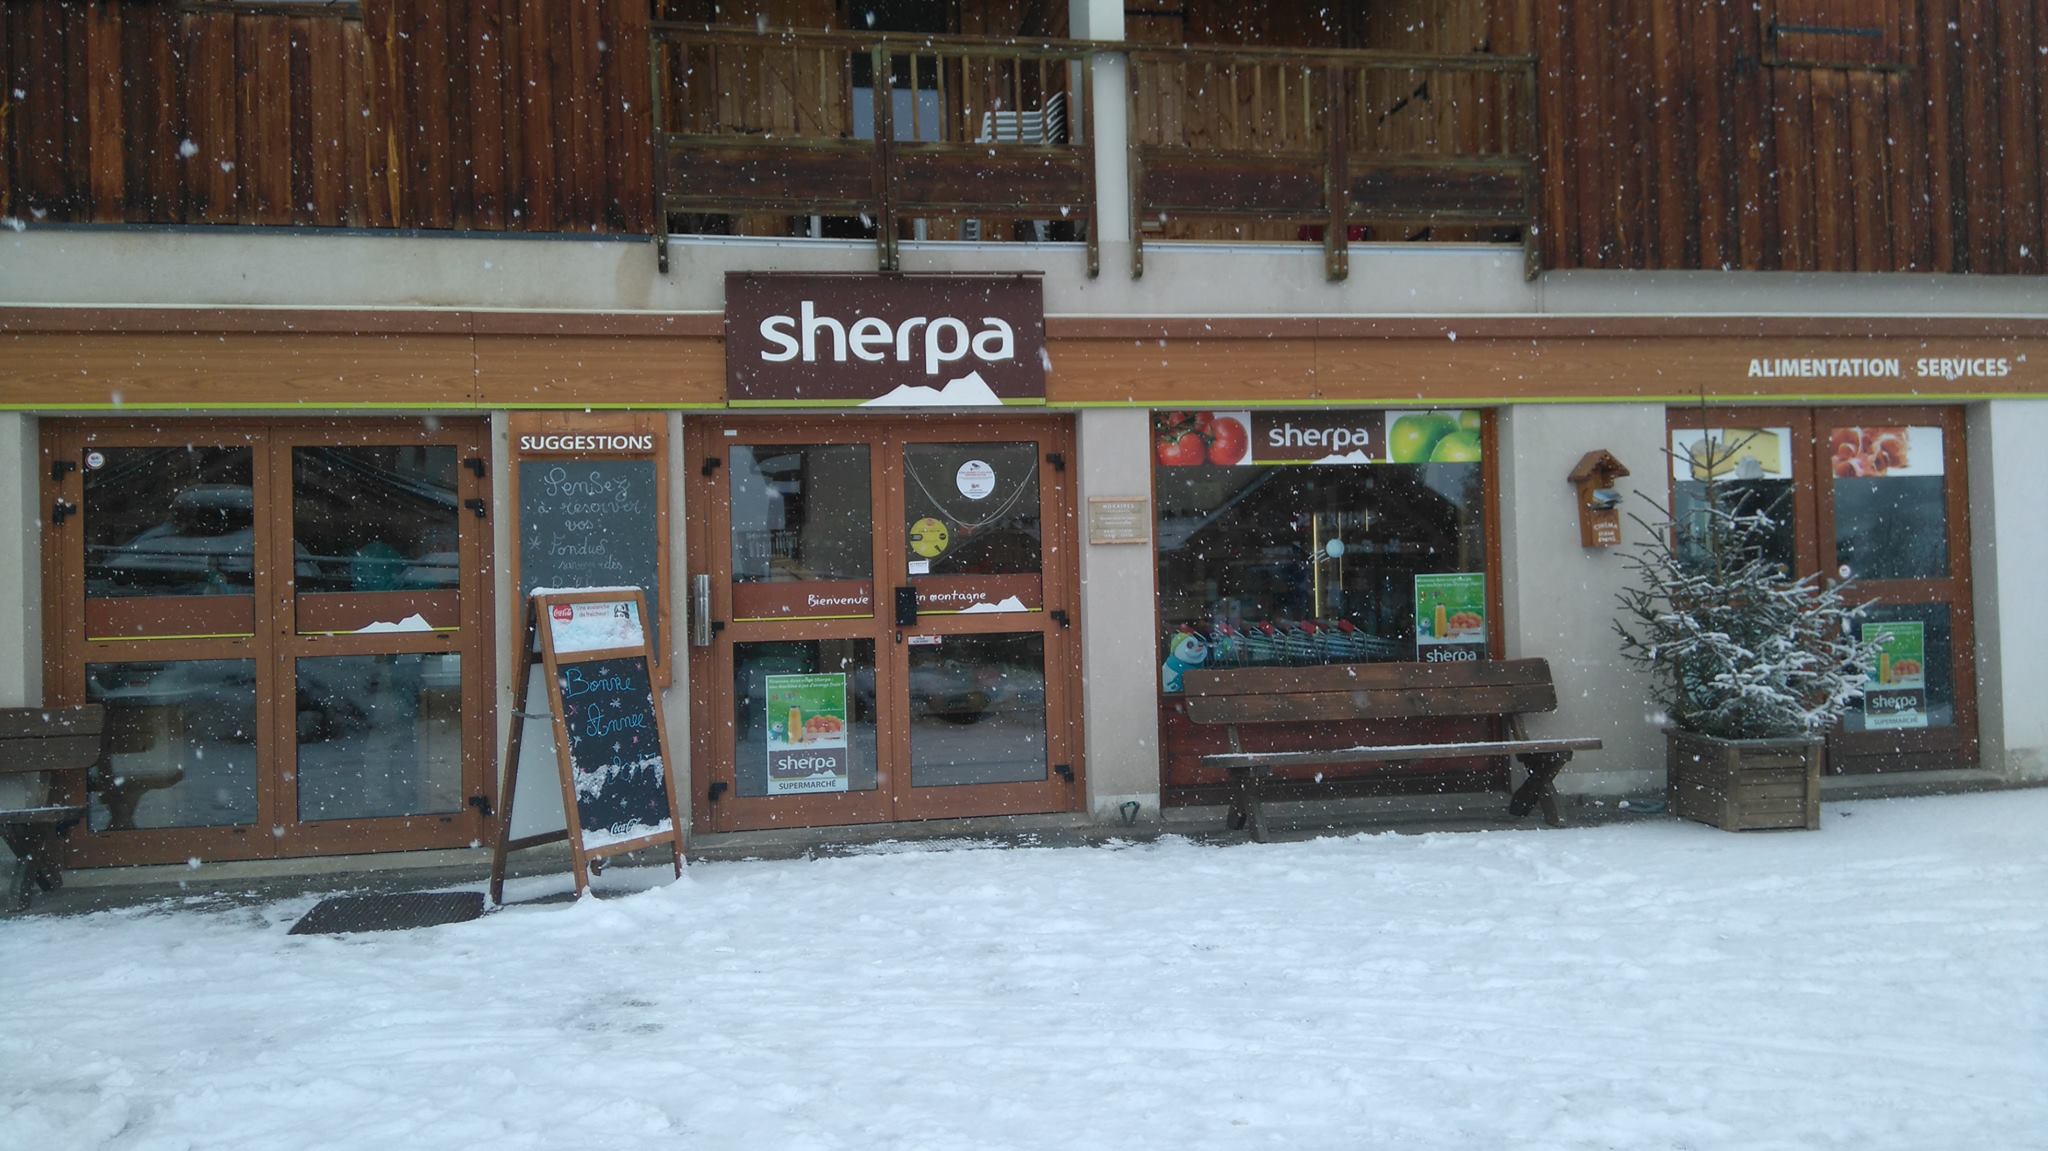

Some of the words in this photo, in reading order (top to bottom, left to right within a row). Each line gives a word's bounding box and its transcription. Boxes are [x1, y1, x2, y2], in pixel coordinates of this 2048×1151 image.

[760, 300, 1014, 375] sherpa
[1748, 358, 1899, 377] ALIMENTATION
[1917, 358, 2008, 377] SERVICES
[520, 435, 652, 450] SUGGESTIONS
[1268, 422, 1369, 451] sherpa
[808, 594, 869, 606] Bienvenue
[929, 590, 986, 603] montagne
[566, 668, 636, 699] Bonne
[1872, 695, 1917, 710] sherpa
[778, 755, 836, 771] sherpa
[778, 780, 836, 790] SUPERMARCHÉ
